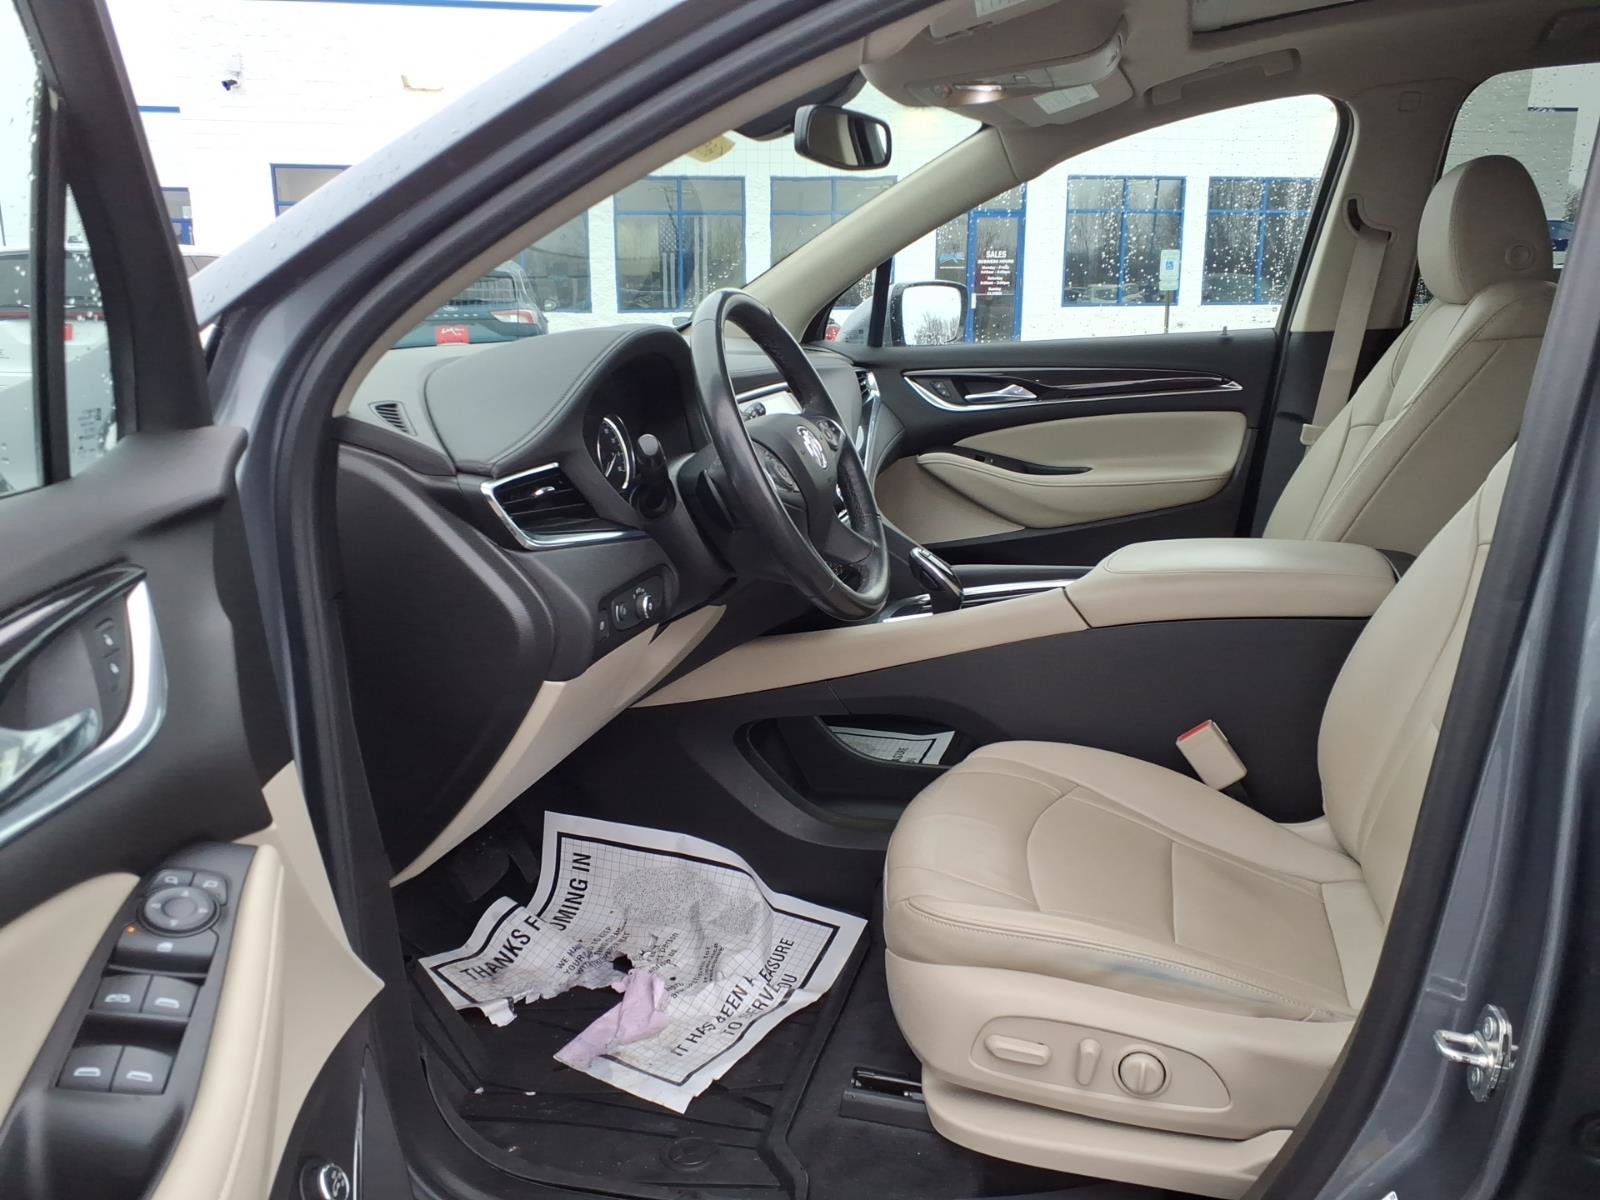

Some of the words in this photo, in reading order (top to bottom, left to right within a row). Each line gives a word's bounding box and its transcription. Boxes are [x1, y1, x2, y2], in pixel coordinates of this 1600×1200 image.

[986, 250, 1007, 258] SALES
[572, 852, 592, 873] IN
[460, 929, 532, 981] THANKS
[670, 1043, 689, 1057] IT
[685, 1020, 717, 1044] HAS
[759, 937, 795, 984] EASURE
[723, 1020, 743, 1036] TO
